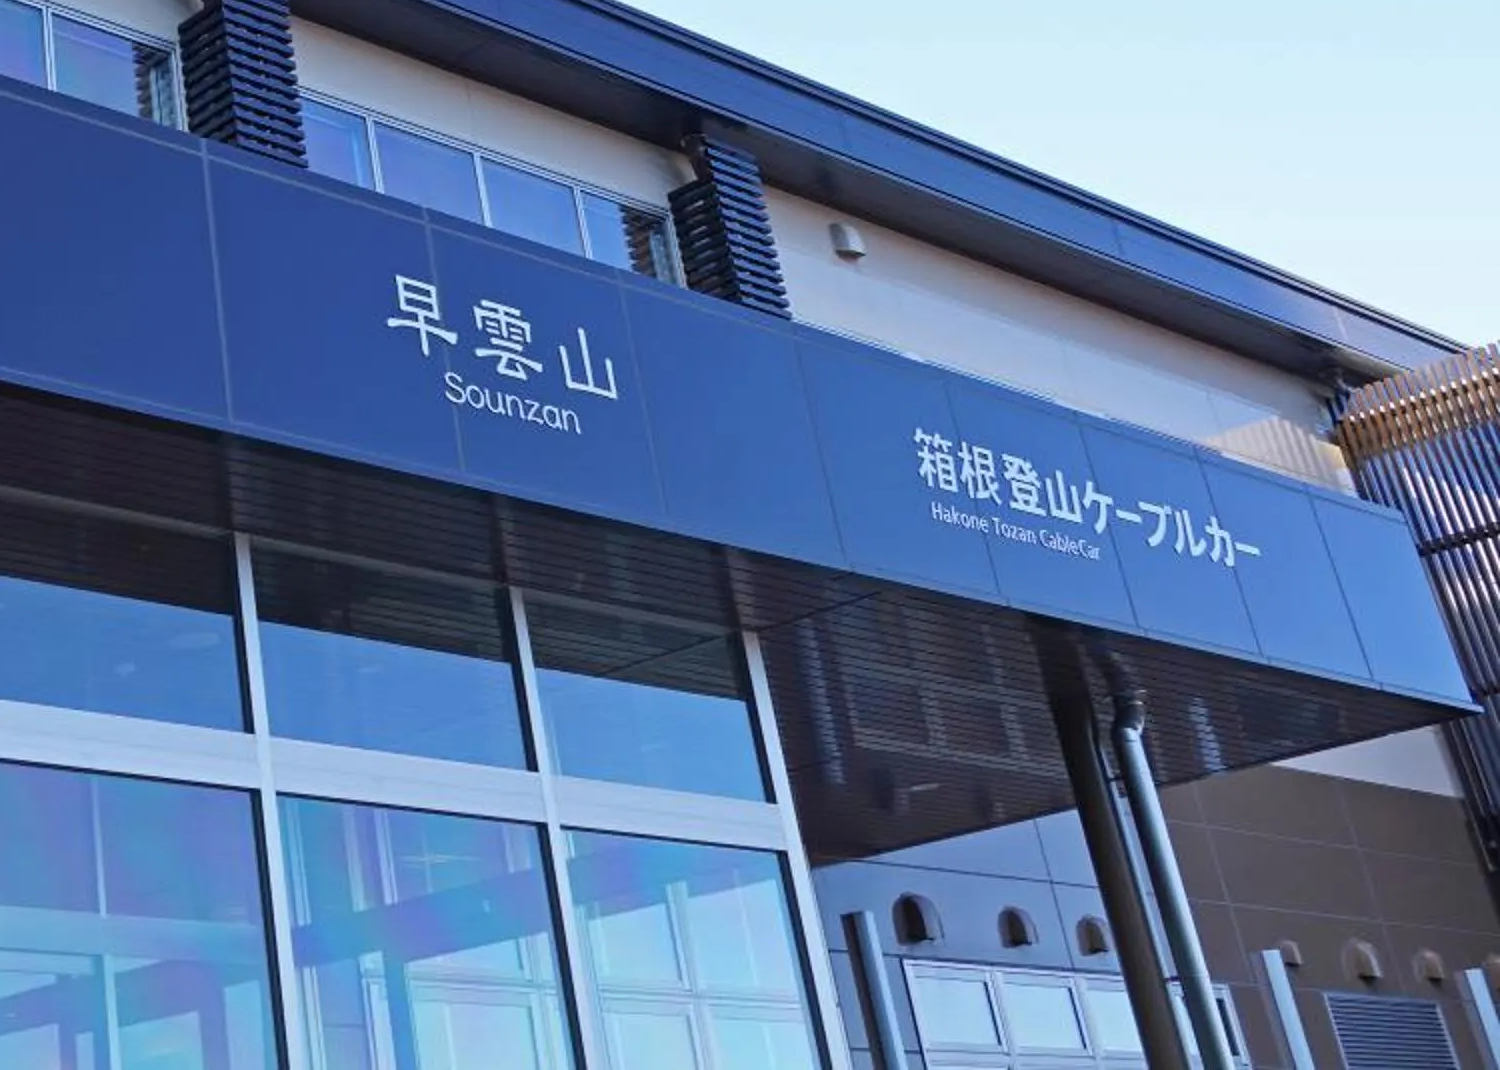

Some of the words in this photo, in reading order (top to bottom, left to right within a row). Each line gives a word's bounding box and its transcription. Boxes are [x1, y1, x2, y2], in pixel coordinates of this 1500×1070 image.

[387, 274, 618, 400] 早雲山
[443, 371, 581, 435] Sounzan
[914, 427, 1261, 567] 箱根登山ケーブルカー
[931, 501, 989, 533] Hakone
[991, 517, 1037, 544] Tozan
